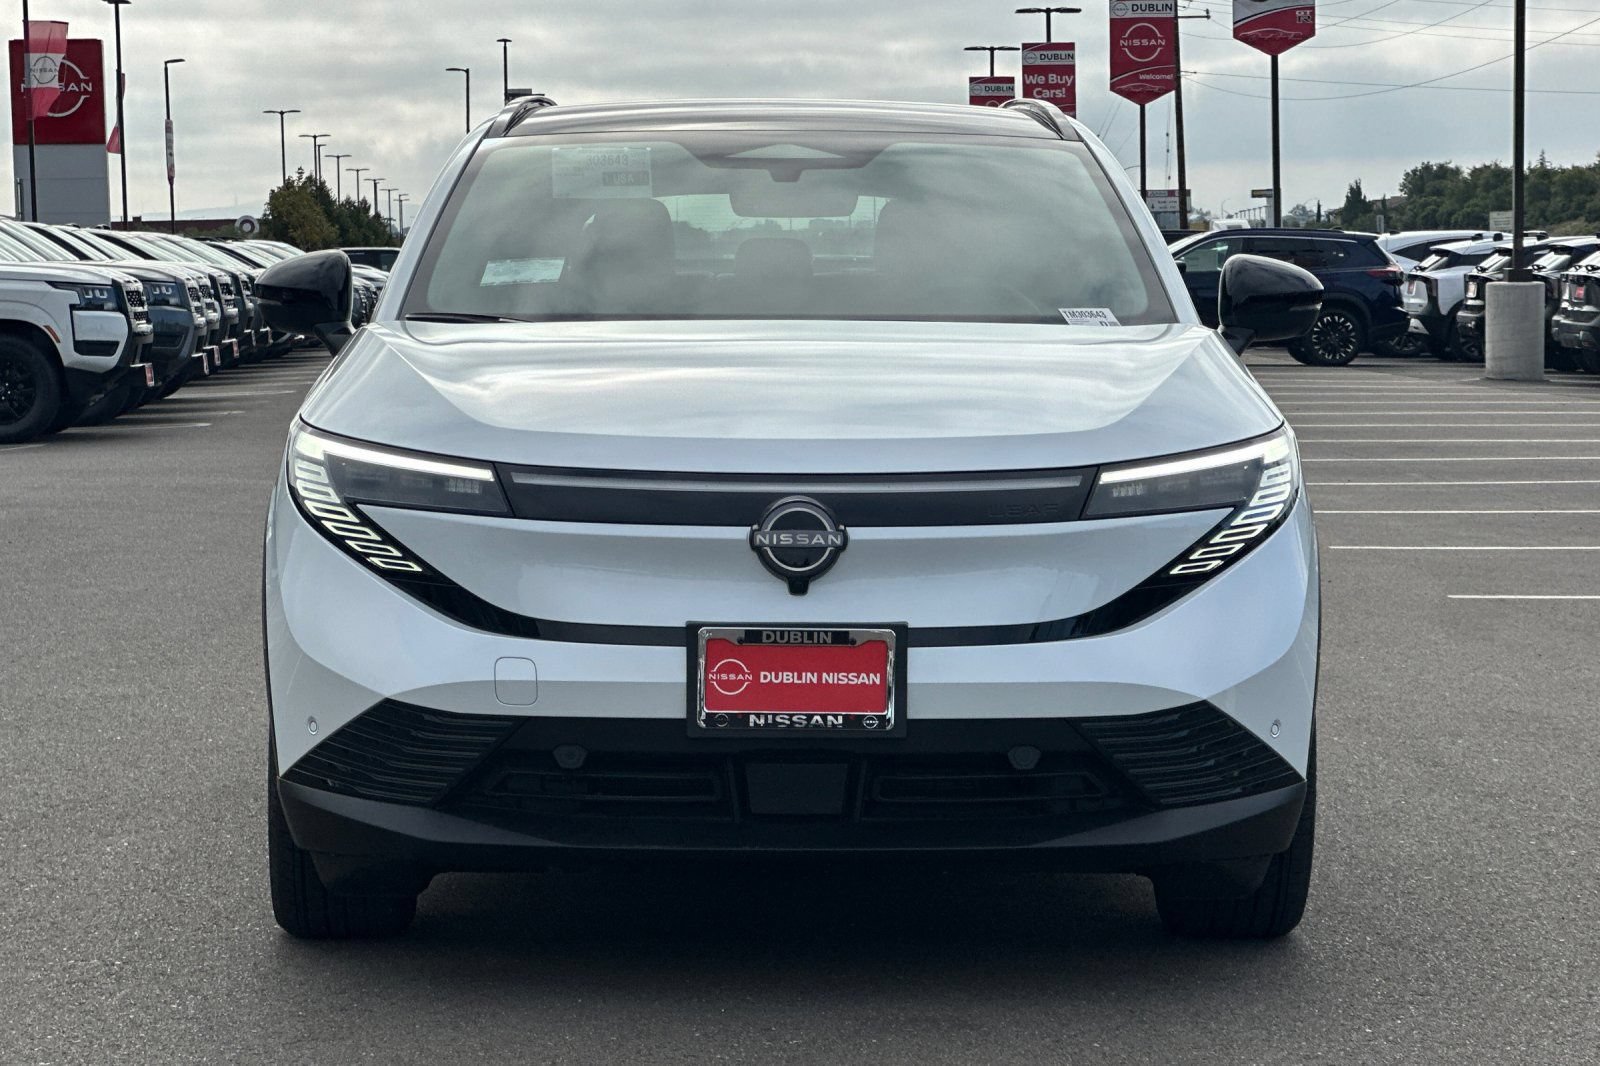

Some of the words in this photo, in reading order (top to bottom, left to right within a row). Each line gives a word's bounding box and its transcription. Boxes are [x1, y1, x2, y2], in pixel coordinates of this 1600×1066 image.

[1131, 3, 1173, 12] DUBLIN
[1040, 53, 1074, 61] DUBLIN
[1024, 73, 1046, 84] We
[1048, 73, 1074, 86] Buy
[1033, 88, 1066, 98] Cars!
[756, 532, 842, 546] NISSAN
[761, 630, 832, 644] DUBLIN
[709, 673, 753, 681] NISSAN
[759, 671, 818, 684] DUBLIN
[822, 672, 881, 685] NISSAN
[749, 714, 843, 728] NISSAN
